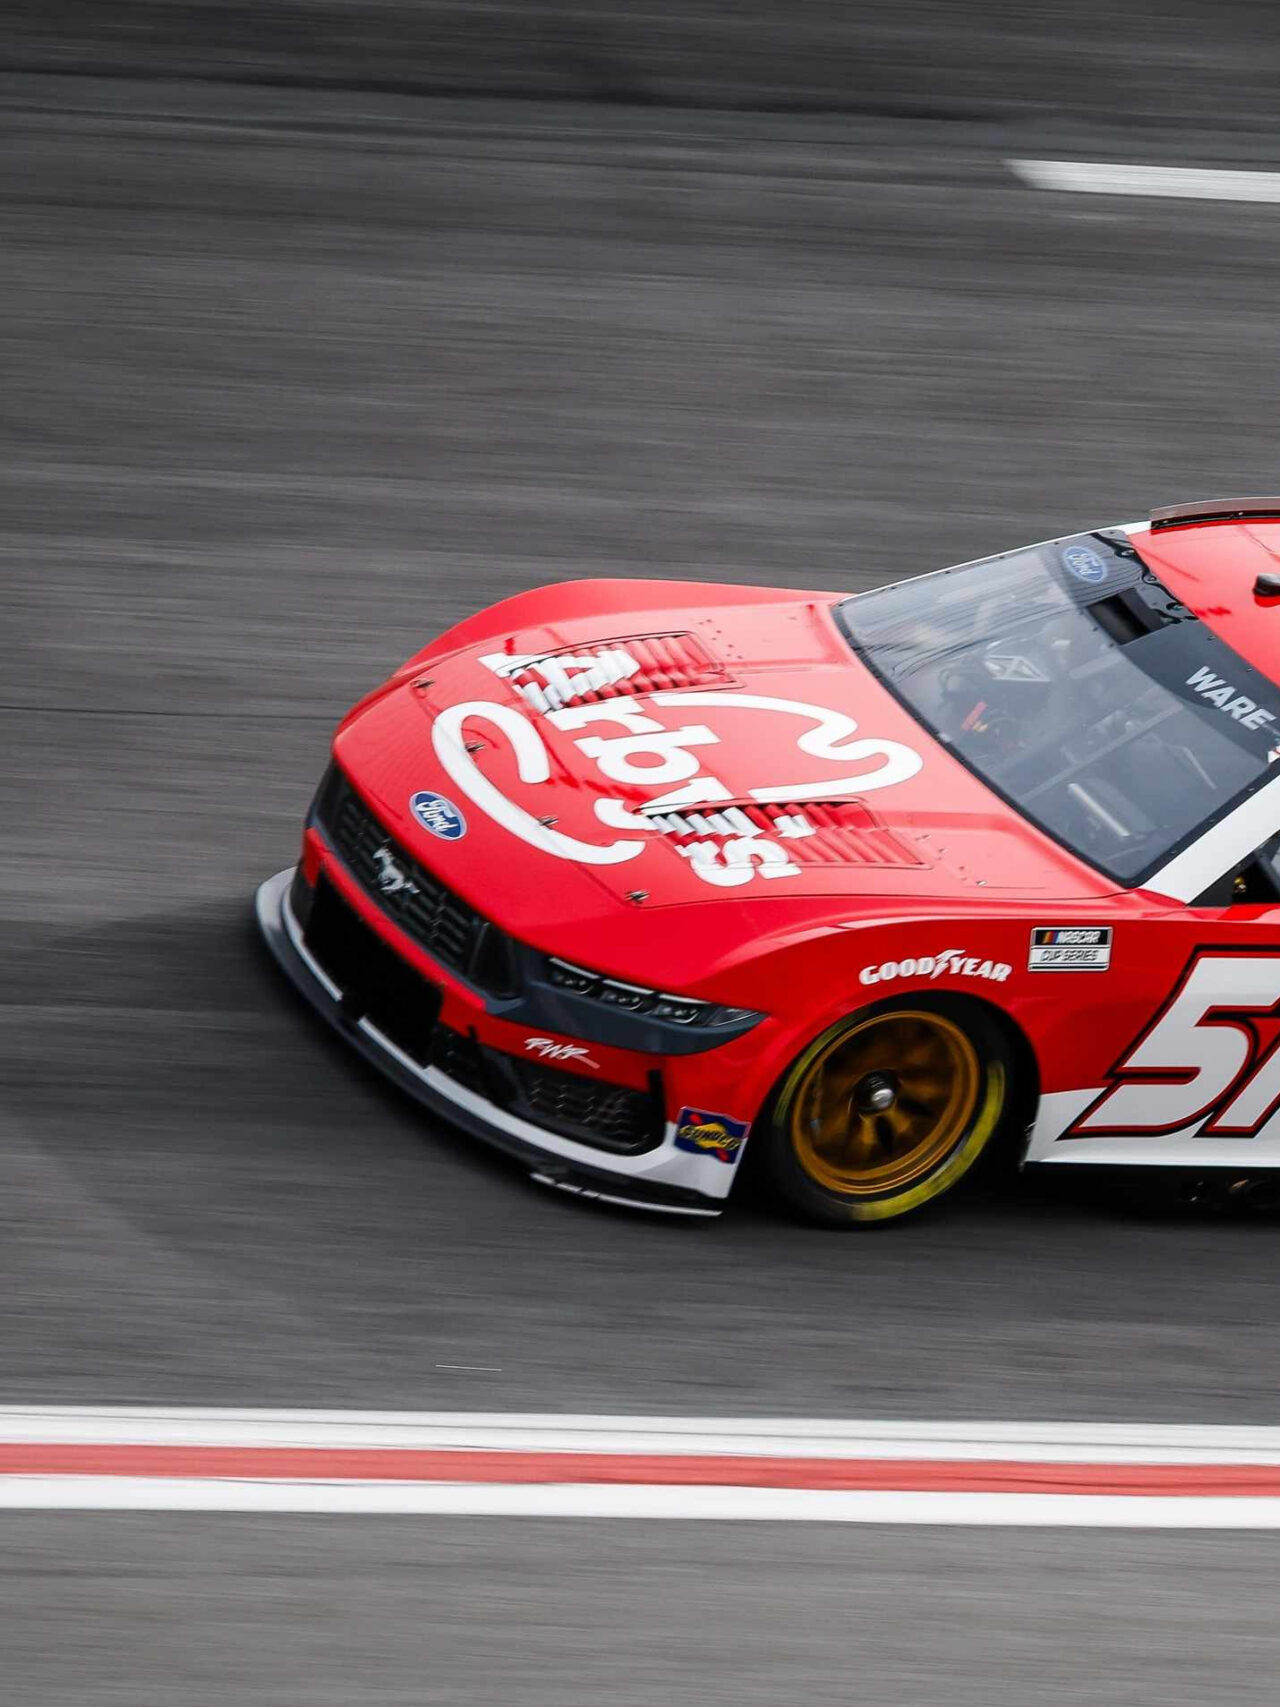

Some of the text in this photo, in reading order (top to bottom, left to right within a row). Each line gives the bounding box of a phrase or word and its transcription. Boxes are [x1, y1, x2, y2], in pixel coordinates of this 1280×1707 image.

[1186, 666, 1276, 730] WARE
[413, 796, 461, 836] Ford
[1055, 930, 1101, 944] NASCAR
[859, 949, 1012, 985] GOODYEAR
[1041, 949, 1099, 962] CUP SERIES
